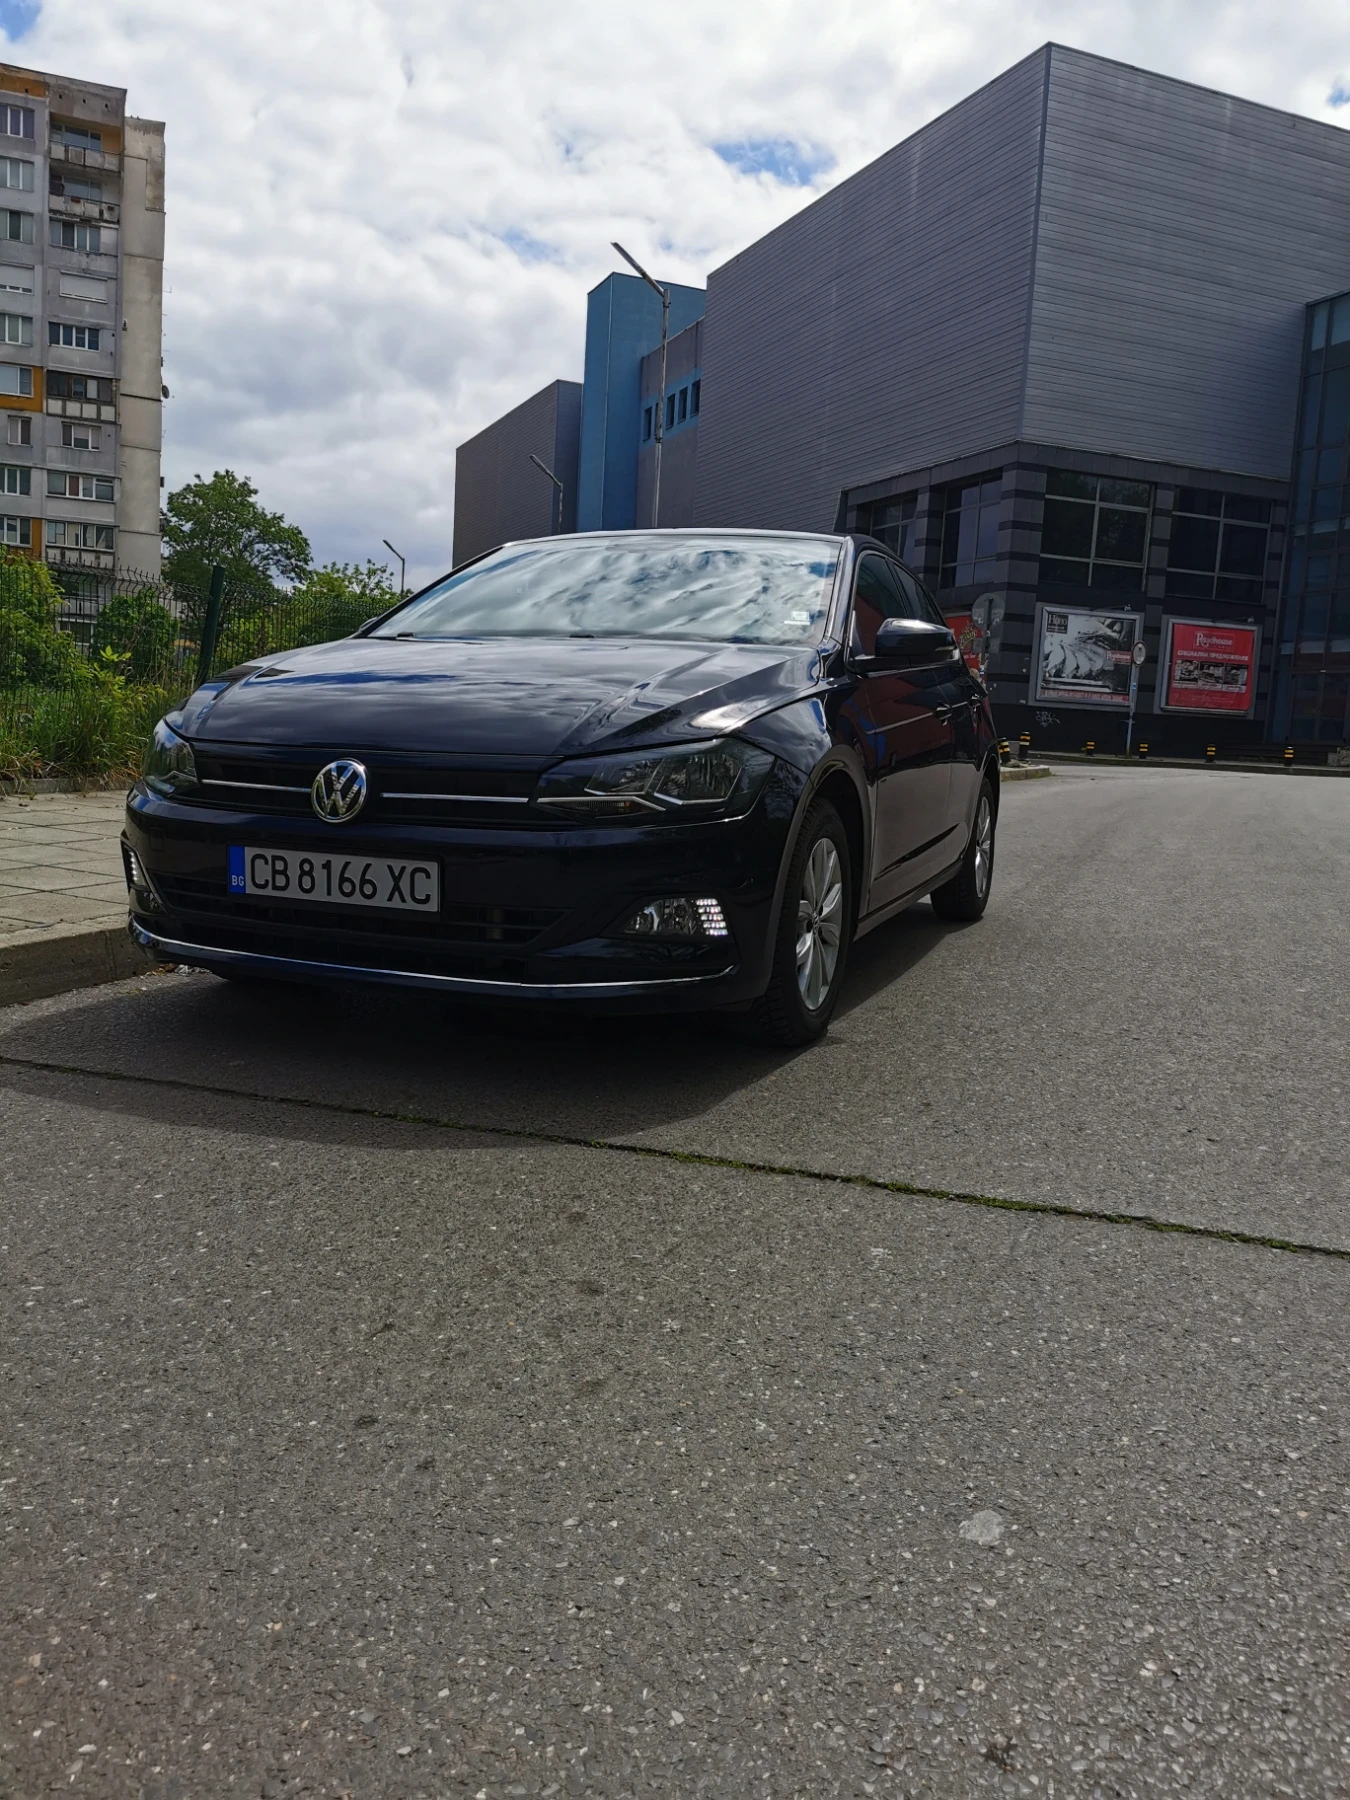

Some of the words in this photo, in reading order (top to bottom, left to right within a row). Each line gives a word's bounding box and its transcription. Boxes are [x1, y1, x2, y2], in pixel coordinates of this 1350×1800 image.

[1196, 632, 1233, 648] Roadhouse
[231, 875, 244, 886] BG
[250, 853, 290, 891] CB
[297, 857, 378, 900] 8166
[386, 864, 431, 905] XC
